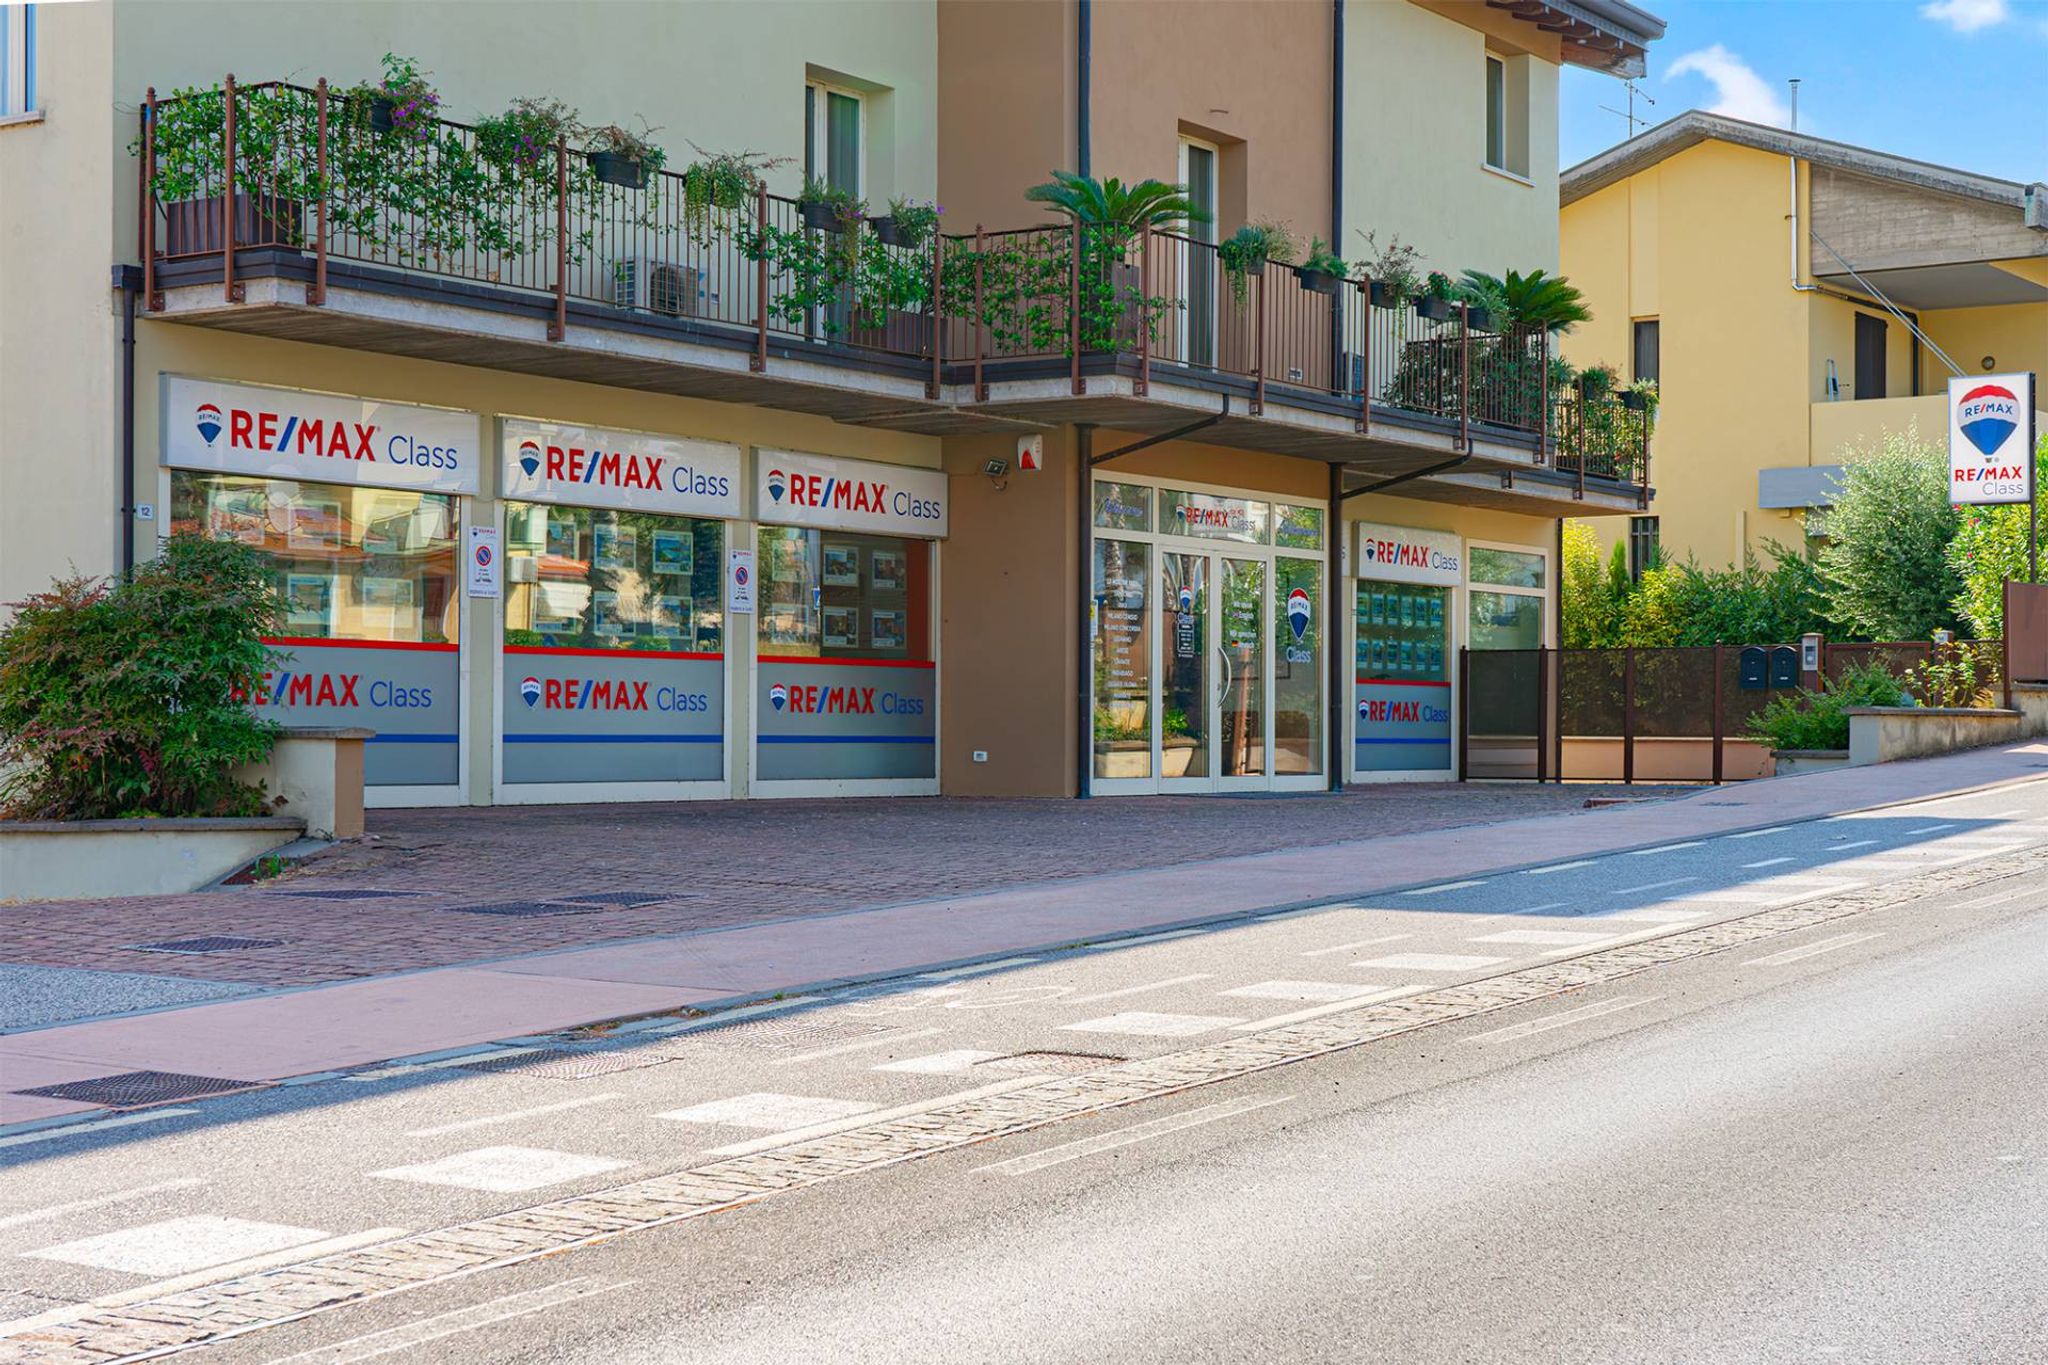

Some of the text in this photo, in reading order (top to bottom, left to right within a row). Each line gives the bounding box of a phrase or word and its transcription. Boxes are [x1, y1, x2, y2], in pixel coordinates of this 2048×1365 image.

[1965, 404, 2013, 417] RE/MAX
[231, 409, 459, 470] RE/MAX Class
[546, 445, 729, 497] RE/MAX Class
[1955, 467, 2022, 481] RE/MAX
[790, 473, 941, 519] RE/MAX Class
[1982, 482, 2024, 495] Class
[141, 506, 151, 517] 12
[1186, 507, 1255, 531] RE/MAX Class
[1377, 541, 1458, 571] RE/MAX Class
[1286, 646, 1312, 663] Class
[369, 680, 432, 707] Class
[545, 679, 708, 712] RE/MAX Class
[789, 685, 924, 715] RE/MAX Class
[1369, 700, 1449, 722] RE/MAX Class
